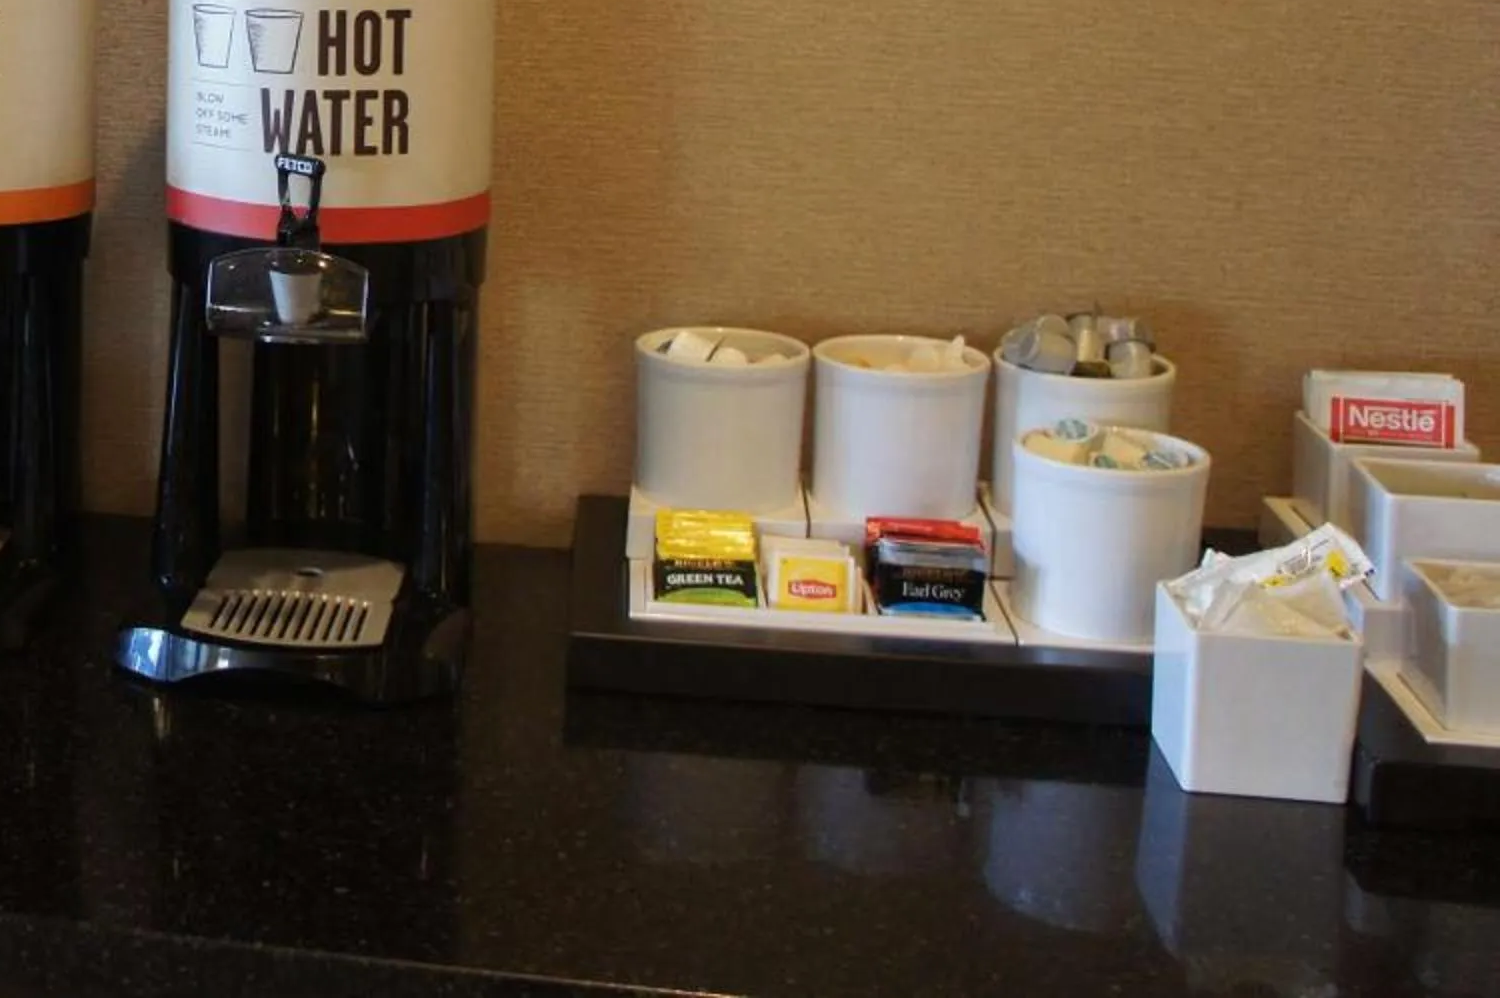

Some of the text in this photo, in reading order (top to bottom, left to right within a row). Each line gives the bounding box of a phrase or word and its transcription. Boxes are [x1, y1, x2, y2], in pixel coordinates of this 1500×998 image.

[317, 9, 412, 76] HOT
[260, 87, 409, 155] WATER
[666, 573, 746, 586] GREEN TEA
[902, 581, 930, 598] Earl
